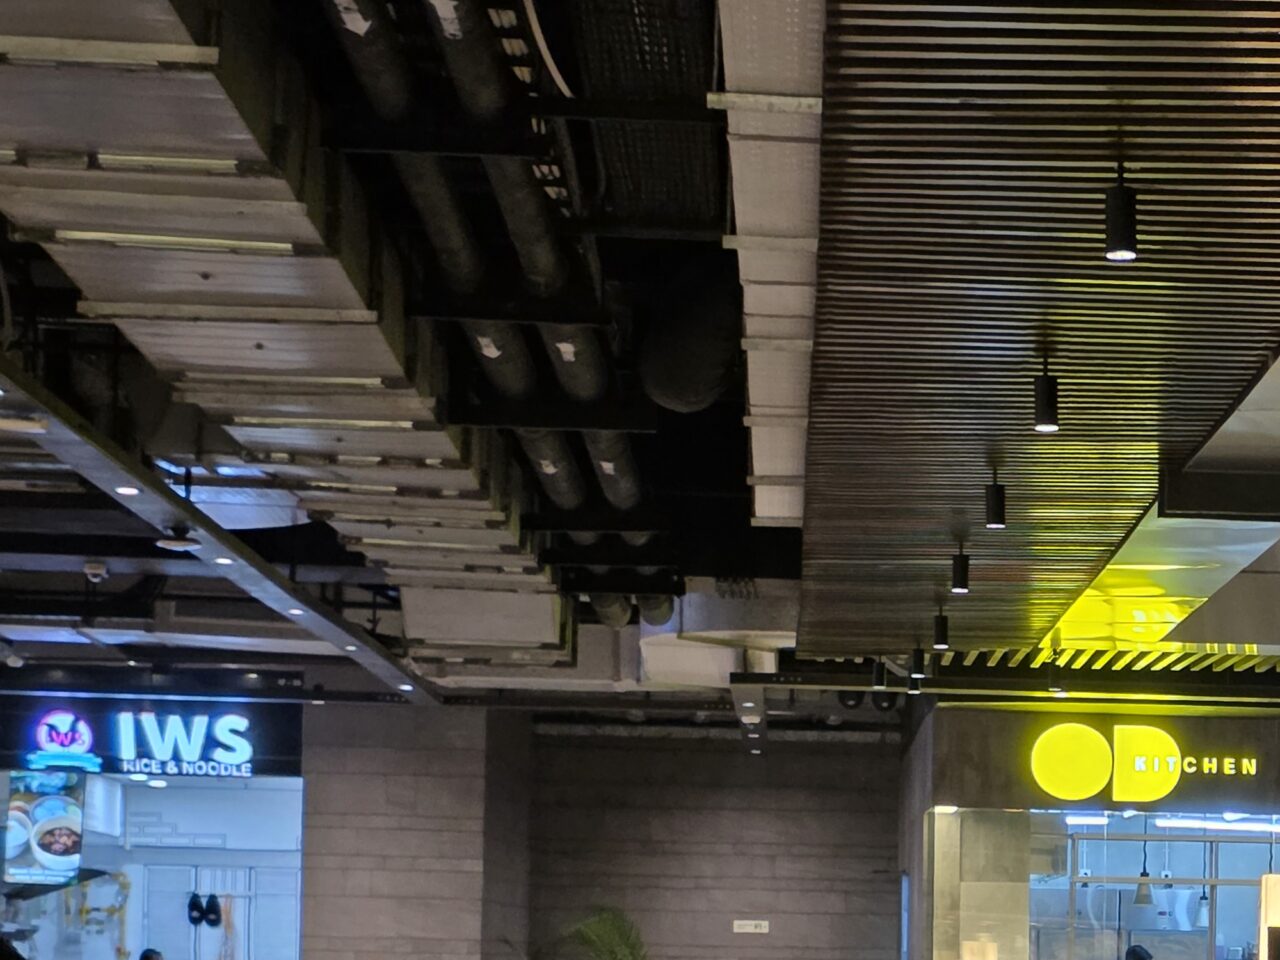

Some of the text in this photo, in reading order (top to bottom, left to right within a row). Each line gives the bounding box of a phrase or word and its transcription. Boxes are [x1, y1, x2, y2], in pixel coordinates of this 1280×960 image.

[118, 711, 254, 765] IWS
[122, 758, 252, 777] RICE & NOODLE
[1134, 755, 1257, 775] KITCHEN
